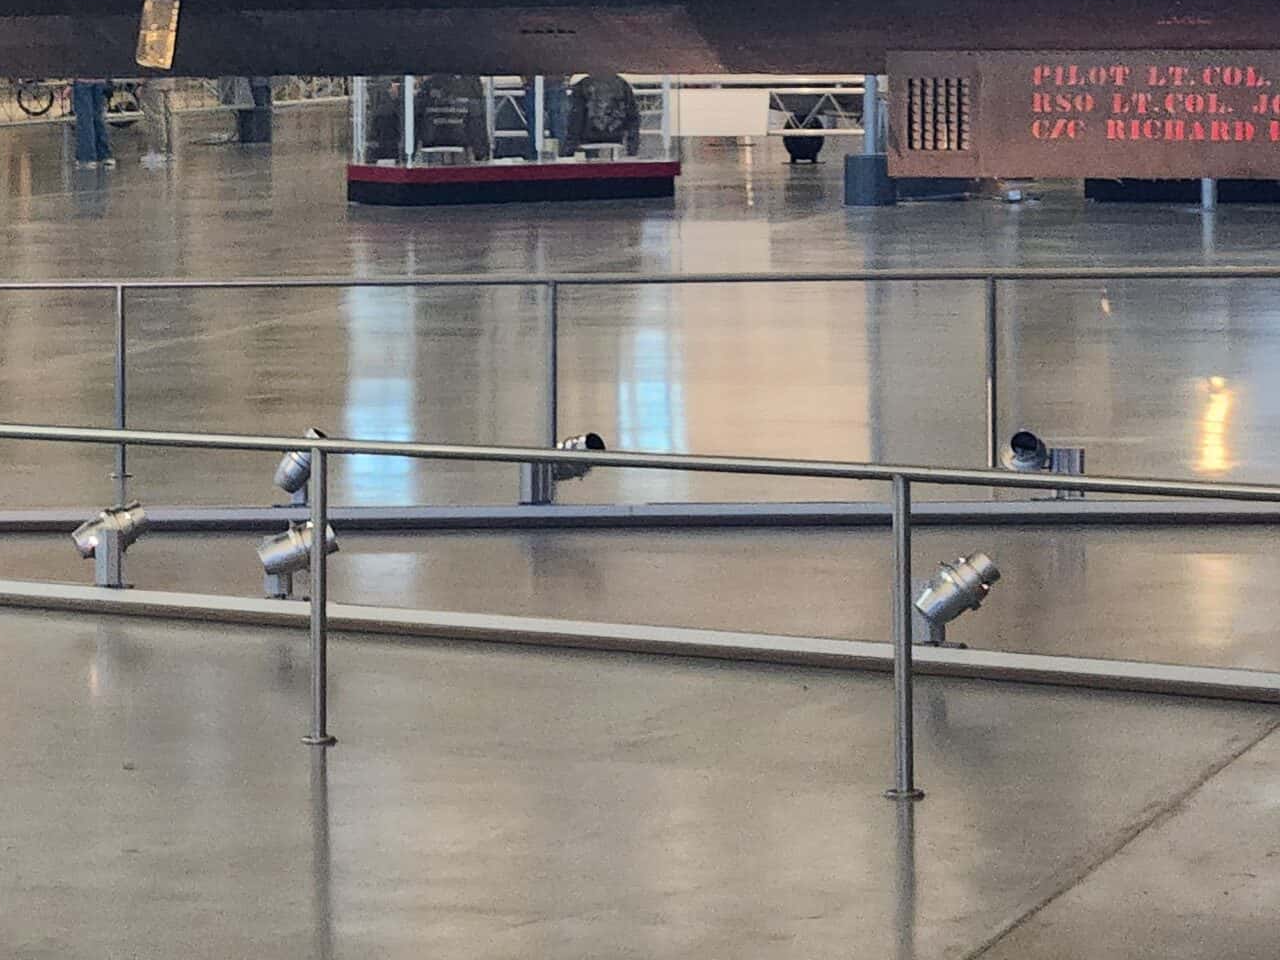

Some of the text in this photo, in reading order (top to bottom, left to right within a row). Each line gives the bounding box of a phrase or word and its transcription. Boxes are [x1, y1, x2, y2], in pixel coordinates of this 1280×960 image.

[1032, 64, 1131, 86] PILOT
[1032, 92, 1096, 113] RSO
[1106, 119, 1256, 141] RICHARD
